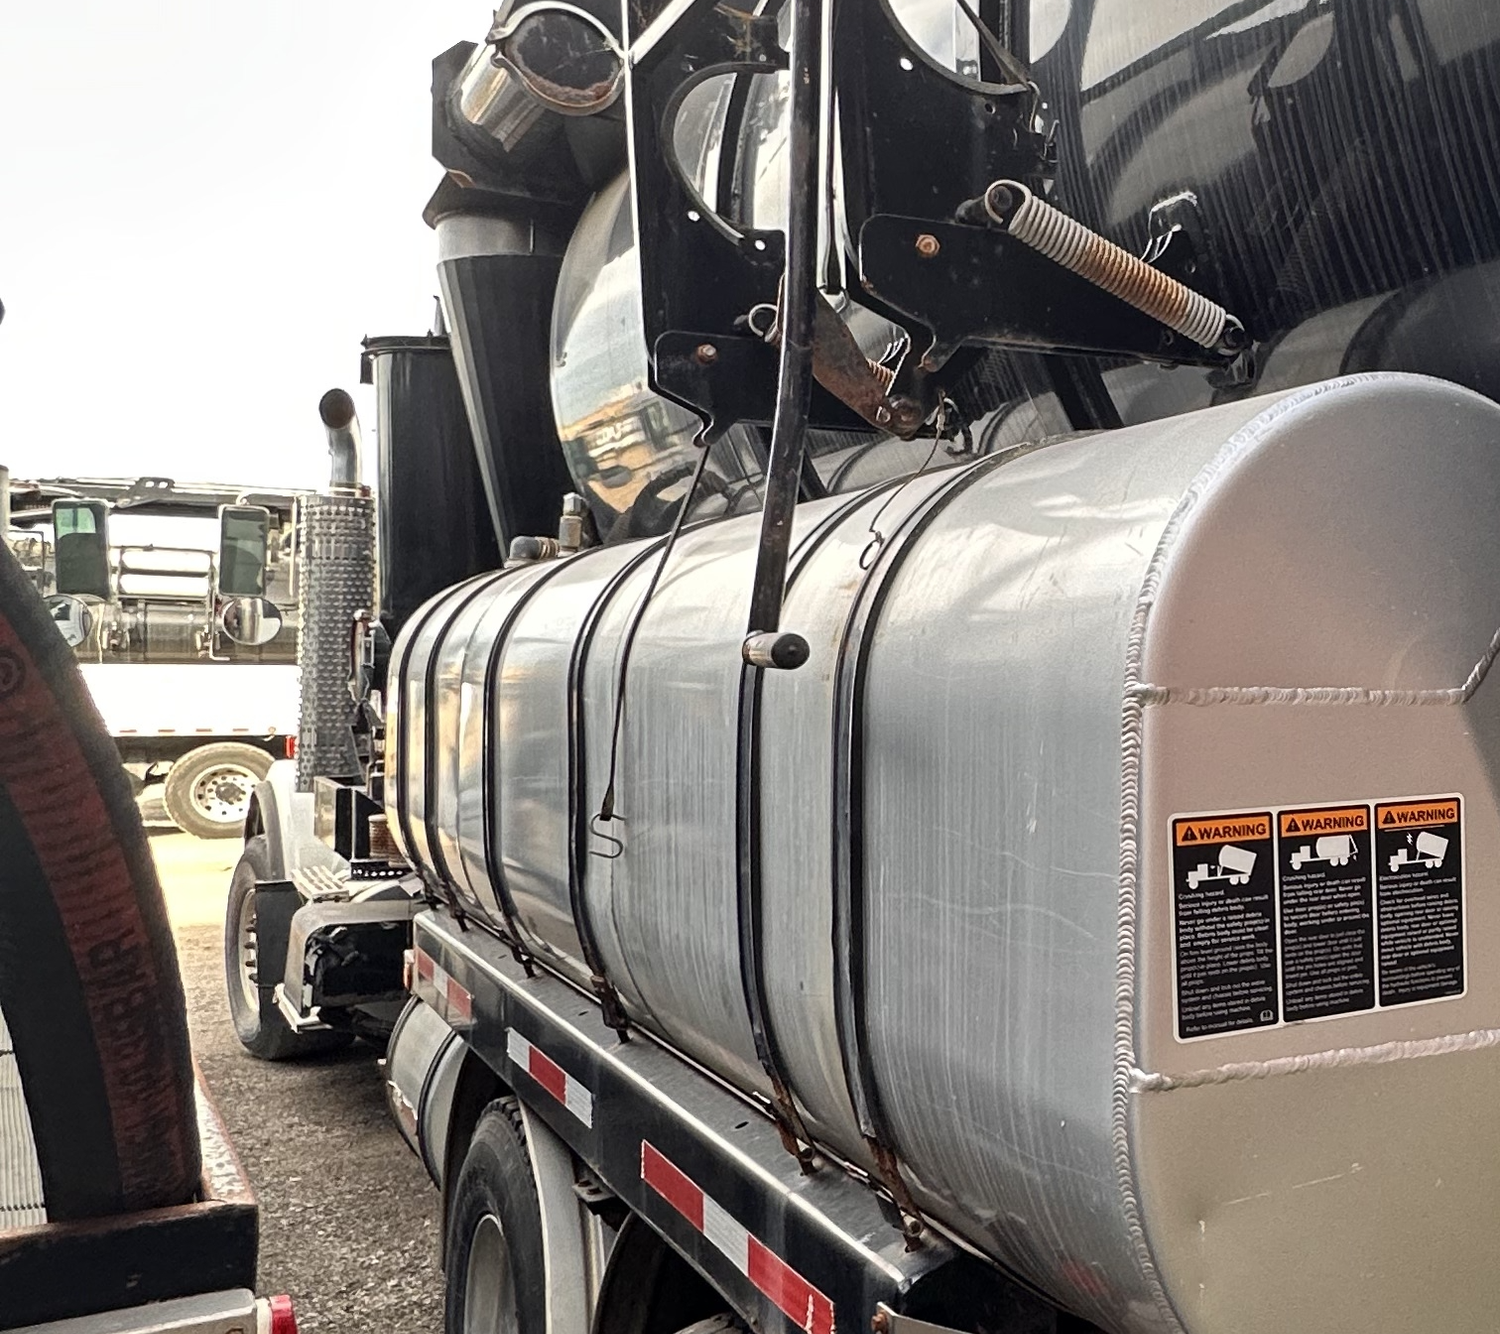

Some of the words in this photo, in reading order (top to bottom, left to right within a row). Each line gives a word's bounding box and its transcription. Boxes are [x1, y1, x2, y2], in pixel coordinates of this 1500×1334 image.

[1301, 815, 1364, 831] WARNING
[1397, 808, 1455, 823] WARNING
[1199, 823, 1266, 840] WARNING
